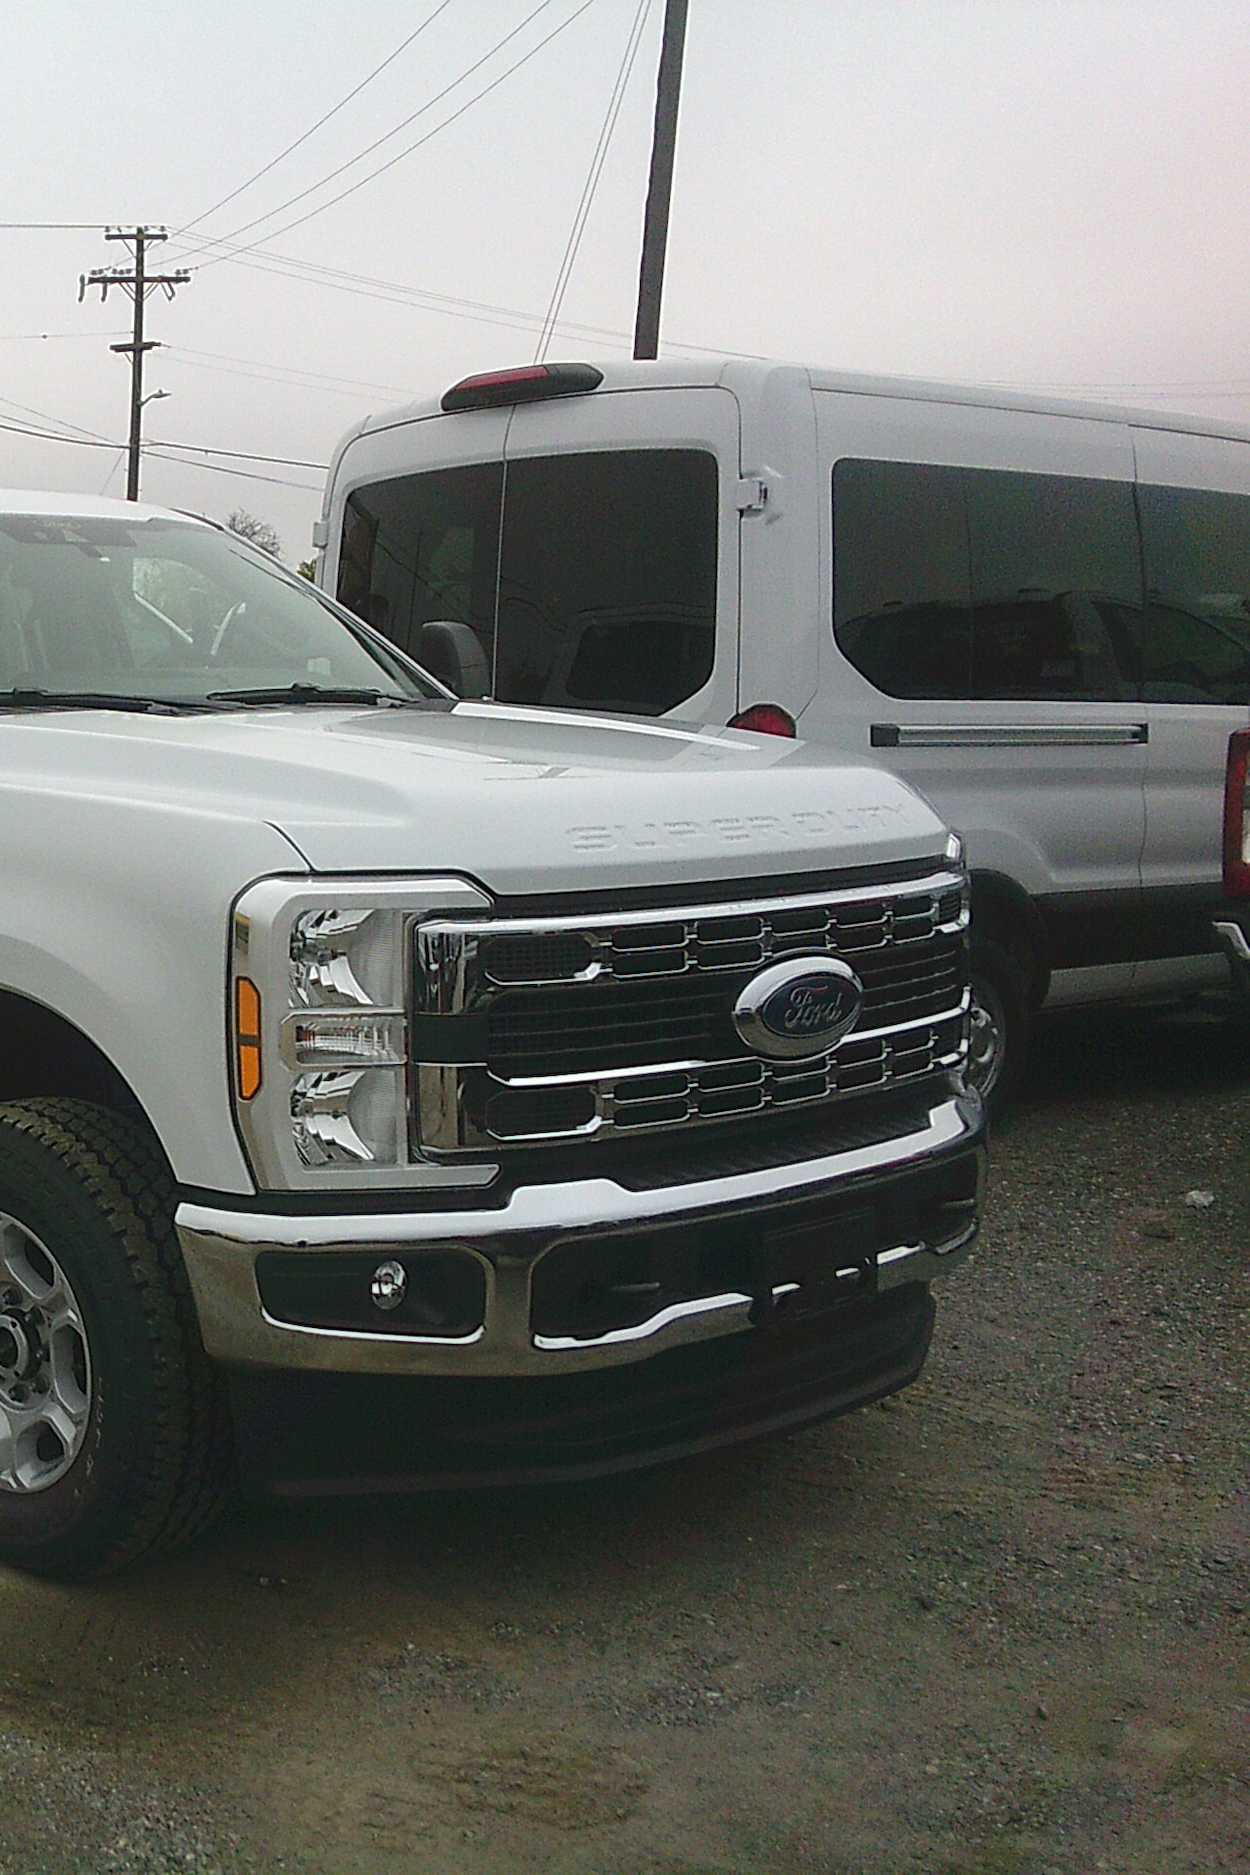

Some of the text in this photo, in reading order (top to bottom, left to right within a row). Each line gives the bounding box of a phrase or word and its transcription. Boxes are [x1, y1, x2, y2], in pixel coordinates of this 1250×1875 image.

[565, 803, 911, 853] SUPER DUTY
[785, 985, 843, 1029] Ford
